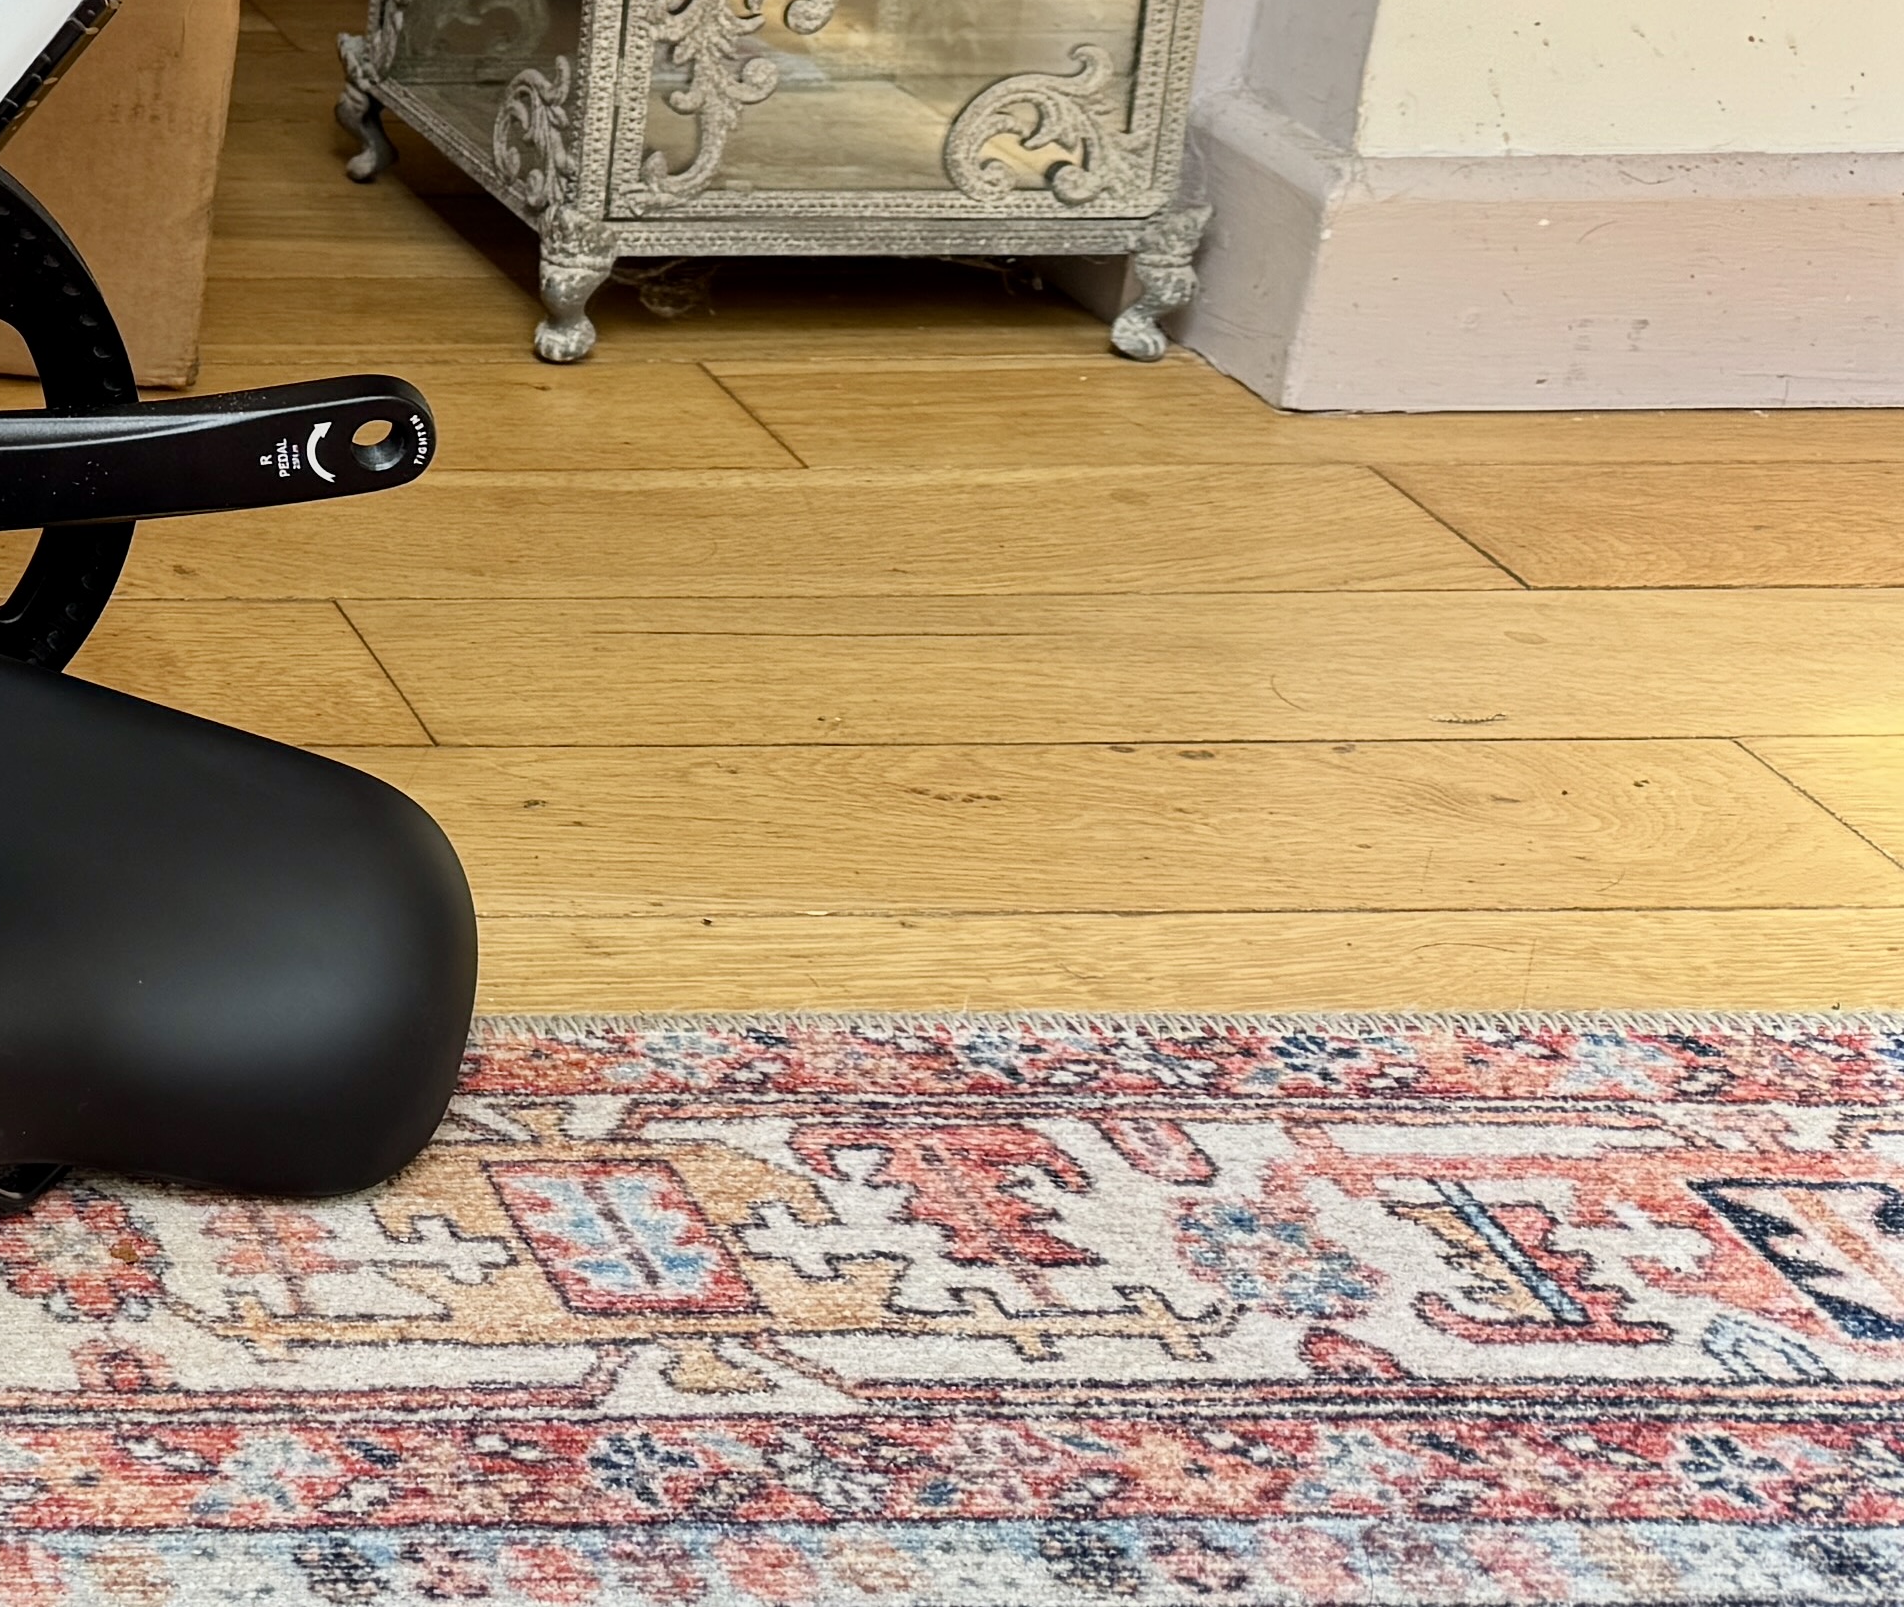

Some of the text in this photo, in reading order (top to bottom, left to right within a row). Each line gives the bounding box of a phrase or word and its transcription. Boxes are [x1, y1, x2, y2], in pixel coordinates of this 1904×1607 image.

[260, 454, 273, 466] R
[276, 438, 291, 478] PEDAL
[409, 414, 429, 466] TIGHTEN
